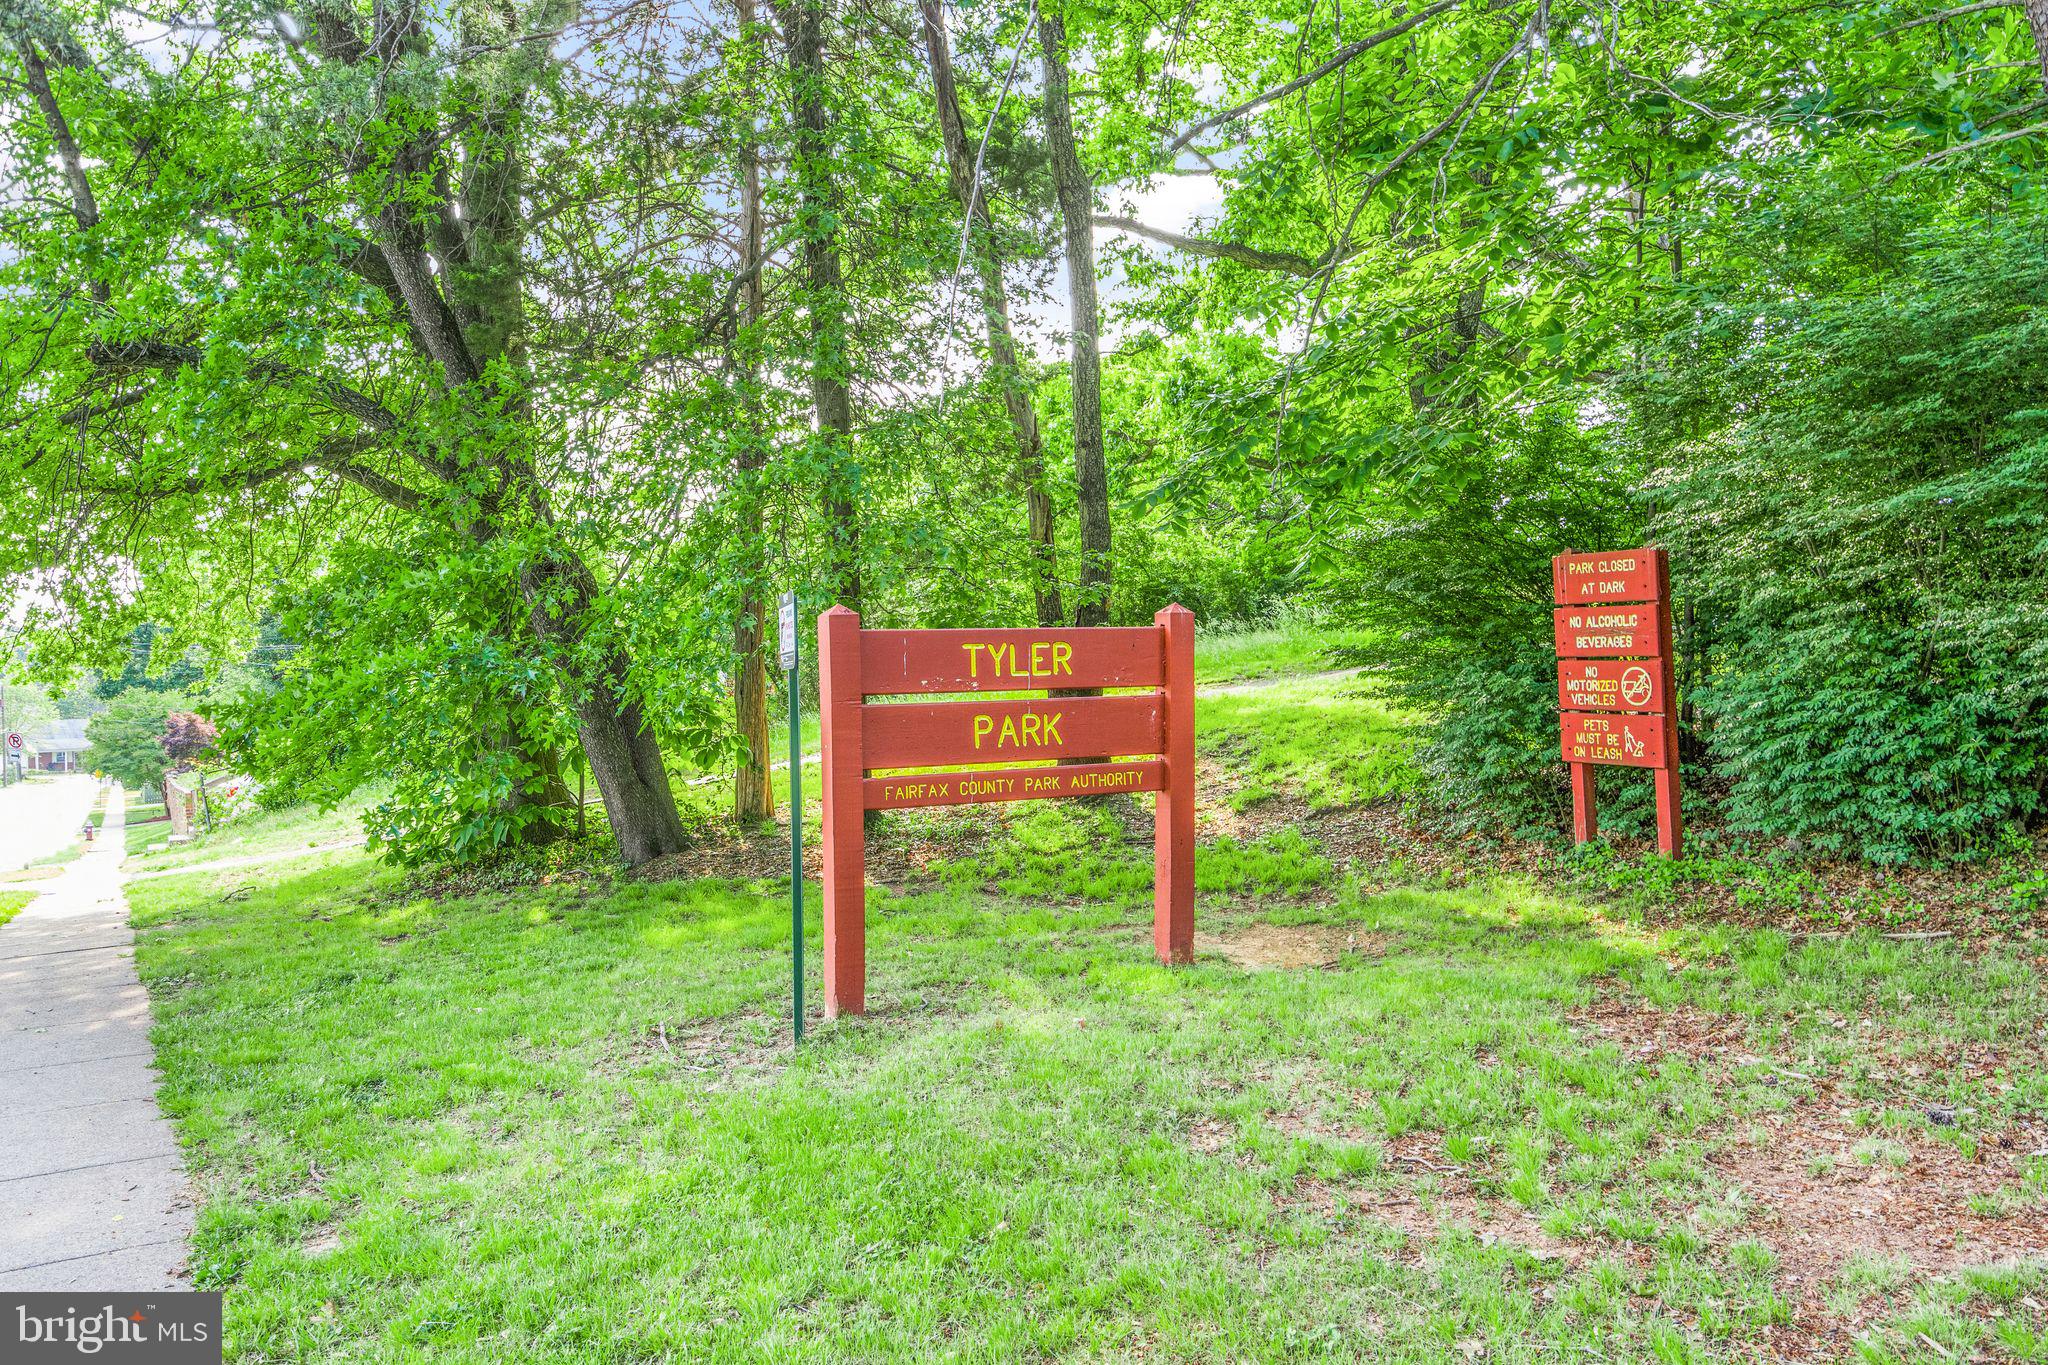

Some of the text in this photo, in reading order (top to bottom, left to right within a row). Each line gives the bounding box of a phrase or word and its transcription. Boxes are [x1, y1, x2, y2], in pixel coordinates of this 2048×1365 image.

[1569, 558, 1636, 575] PARK CLOSED
[1581, 581, 1626, 595] AT DARK
[1569, 614, 1638, 628] NO ALCOHOLIC
[1575, 635, 1633, 649] BEVERAGES
[962, 641, 1072, 677] TYLER
[1585, 666, 1598, 678] NO
[1566, 679, 1619, 692] MOTORIZED
[1571, 693, 1616, 706] VEHICLES
[974, 712, 1062, 749] PARK
[1583, 719, 1610, 732] PETS
[1575, 732, 1620, 746] MUST BE
[1573, 746, 1623, 761] ON LEASH
[884, 770, 1144, 801] FAIRFAX COUNTY PARK AUTHORITY
